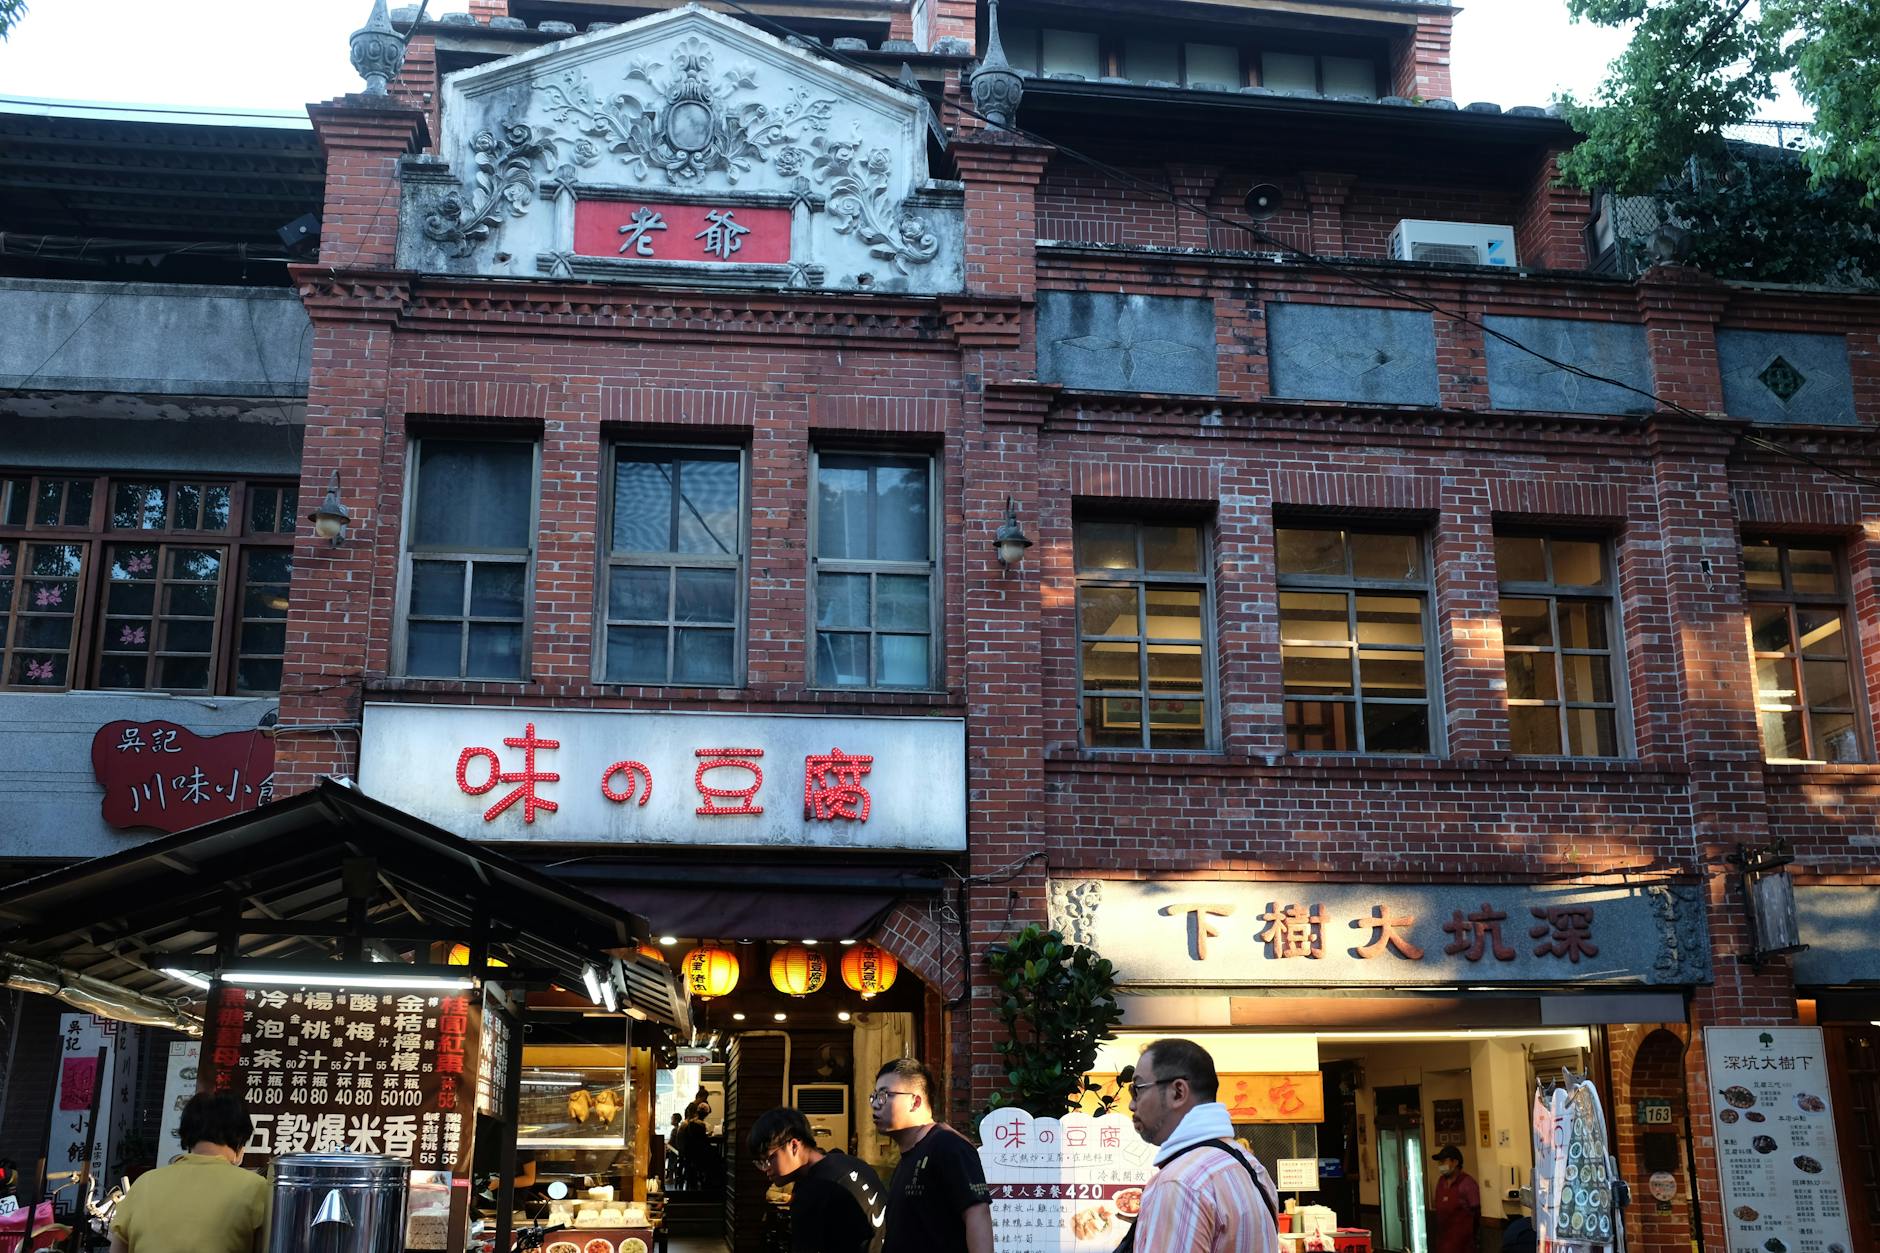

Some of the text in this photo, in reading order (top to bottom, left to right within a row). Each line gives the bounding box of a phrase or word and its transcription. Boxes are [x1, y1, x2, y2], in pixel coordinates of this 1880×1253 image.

[619, 206, 751, 259] 老爺
[117, 727, 182, 753] 吳記
[456, 722, 874, 824] 味の豆腐
[65, 1020, 83, 1051] 吳記
[252, 990, 289, 1068] 冷泡茶
[298, 992, 334, 1069] 楊桃汁
[343, 994, 378, 1070] 酸梅汁
[390, 994, 425, 1071] 金桔檸檬
[239, 1057, 250, 1066] 55
[285, 1060, 297, 1069] 60
[330, 1061, 342, 1070] 55
[376, 1061, 387, 1070] 55
[422, 1063, 433, 1072] 55
[1723, 1055, 1813, 1070] 深坑大樹下
[245, 1088, 263, 1104] 40
[265, 1088, 284, 1104] 80
[290, 1088, 308, 1104] 40
[310, 1088, 329, 1105] 80
[334, 1089, 353, 1105] 40
[355, 1089, 373, 1105] 80
[438, 1092, 455, 1108] 55
[1648, 1107, 1669, 1121] 163
[244, 1112, 418, 1157] 五穀爆米香
[995, 1118, 1121, 1149] 味の豆腐
[420, 1153, 437, 1164] 55
[441, 1153, 458, 1164] 55
[1002, 1184, 1062, 1198] 雙人套餐
[1065, 1184, 1103, 1199] 420
